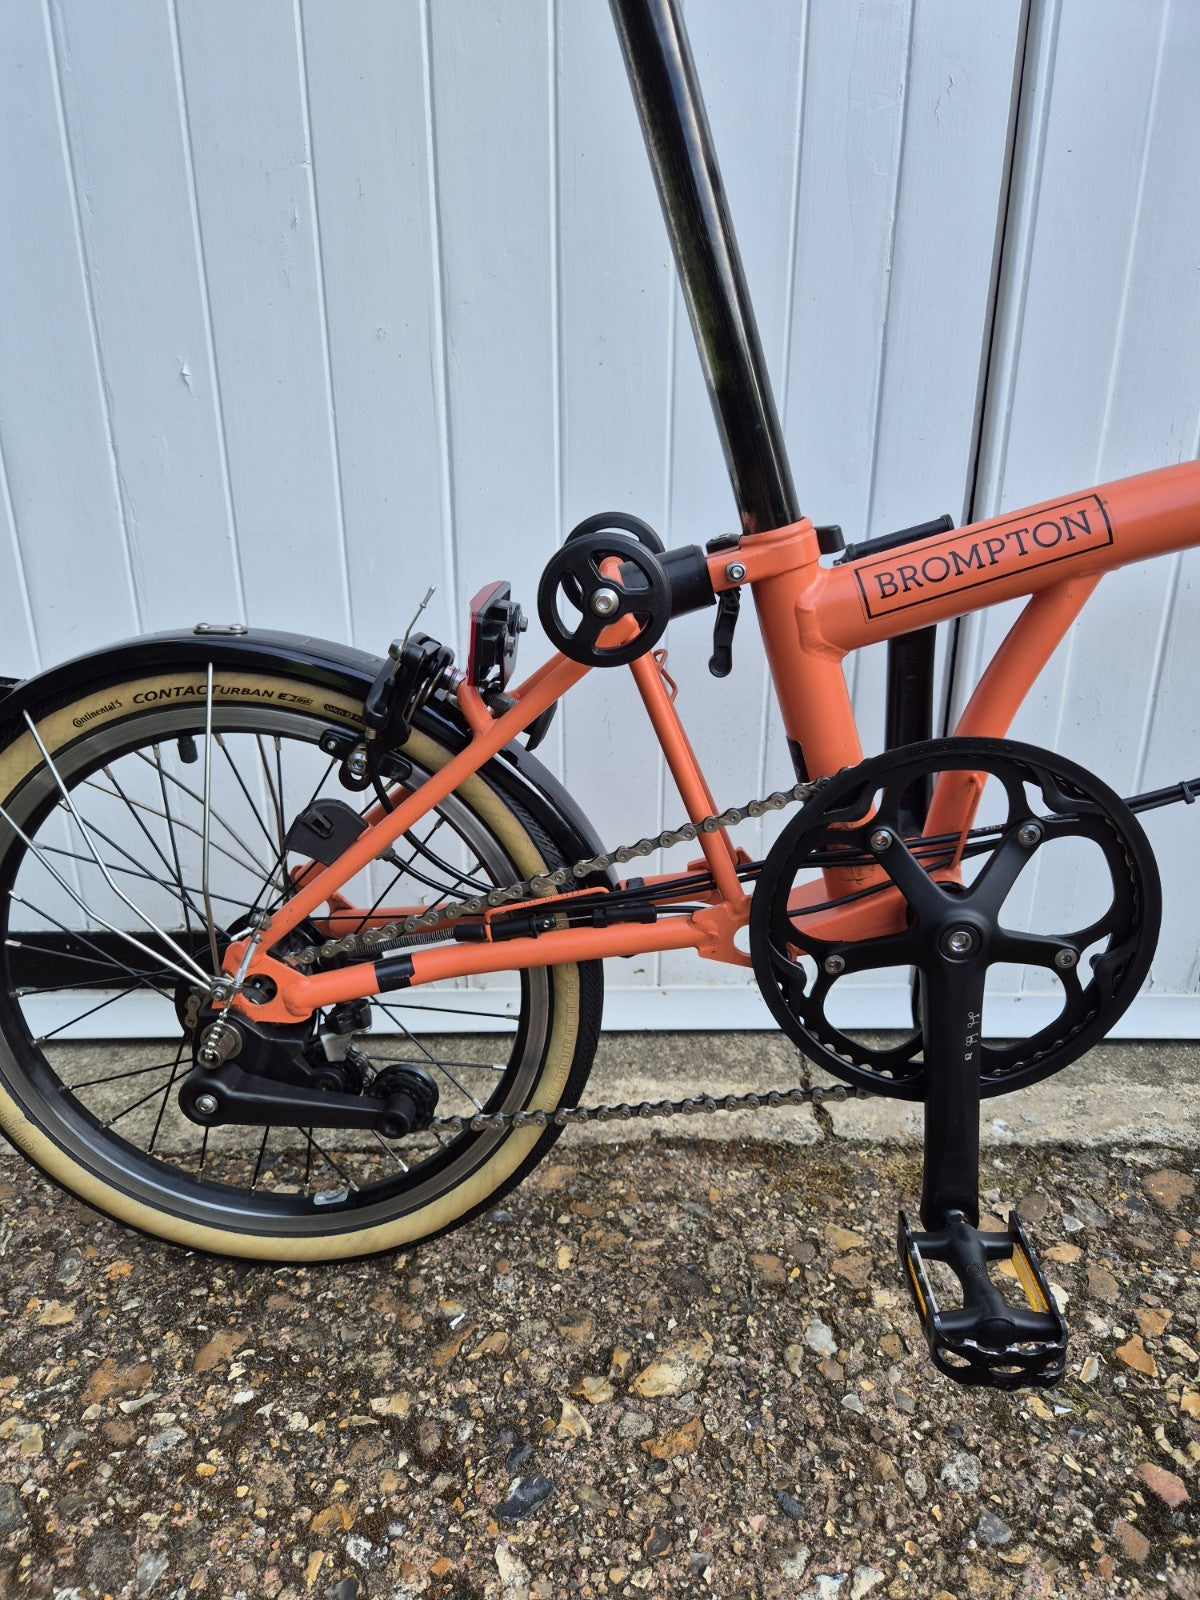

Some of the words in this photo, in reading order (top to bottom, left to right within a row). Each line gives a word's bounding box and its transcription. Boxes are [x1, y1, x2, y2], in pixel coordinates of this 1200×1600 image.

[874, 509, 1092, 600] BROMPTON
[132, 685, 220, 704] CONTACT
[219, 687, 275, 698] URBAN
[72, 700, 117, 728] Continental
